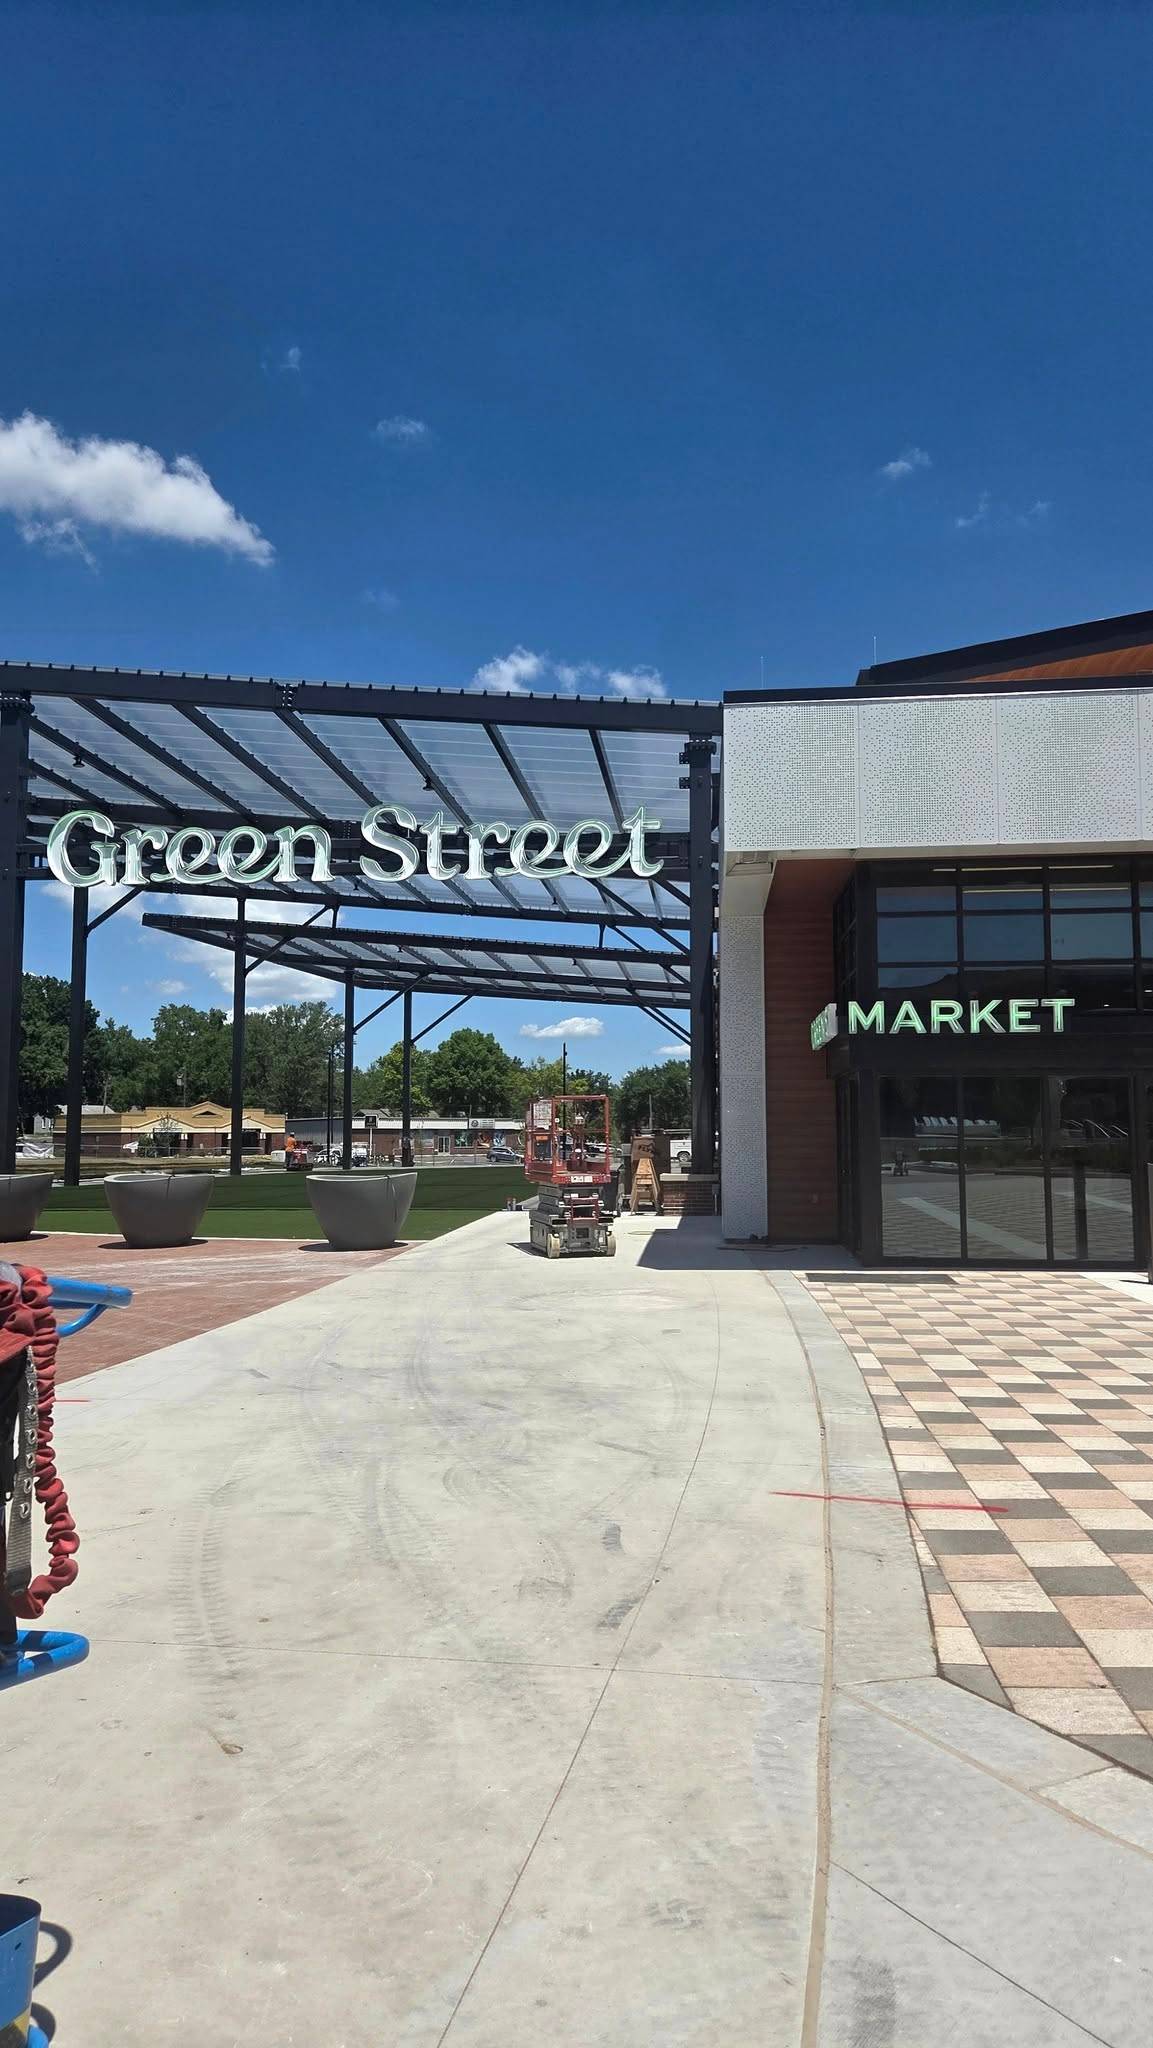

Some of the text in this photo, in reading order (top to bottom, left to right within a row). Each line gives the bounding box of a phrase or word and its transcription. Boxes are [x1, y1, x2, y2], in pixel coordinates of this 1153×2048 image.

[47, 804, 664, 887] Green Street
[848, 999, 1075, 1034] MARKET
